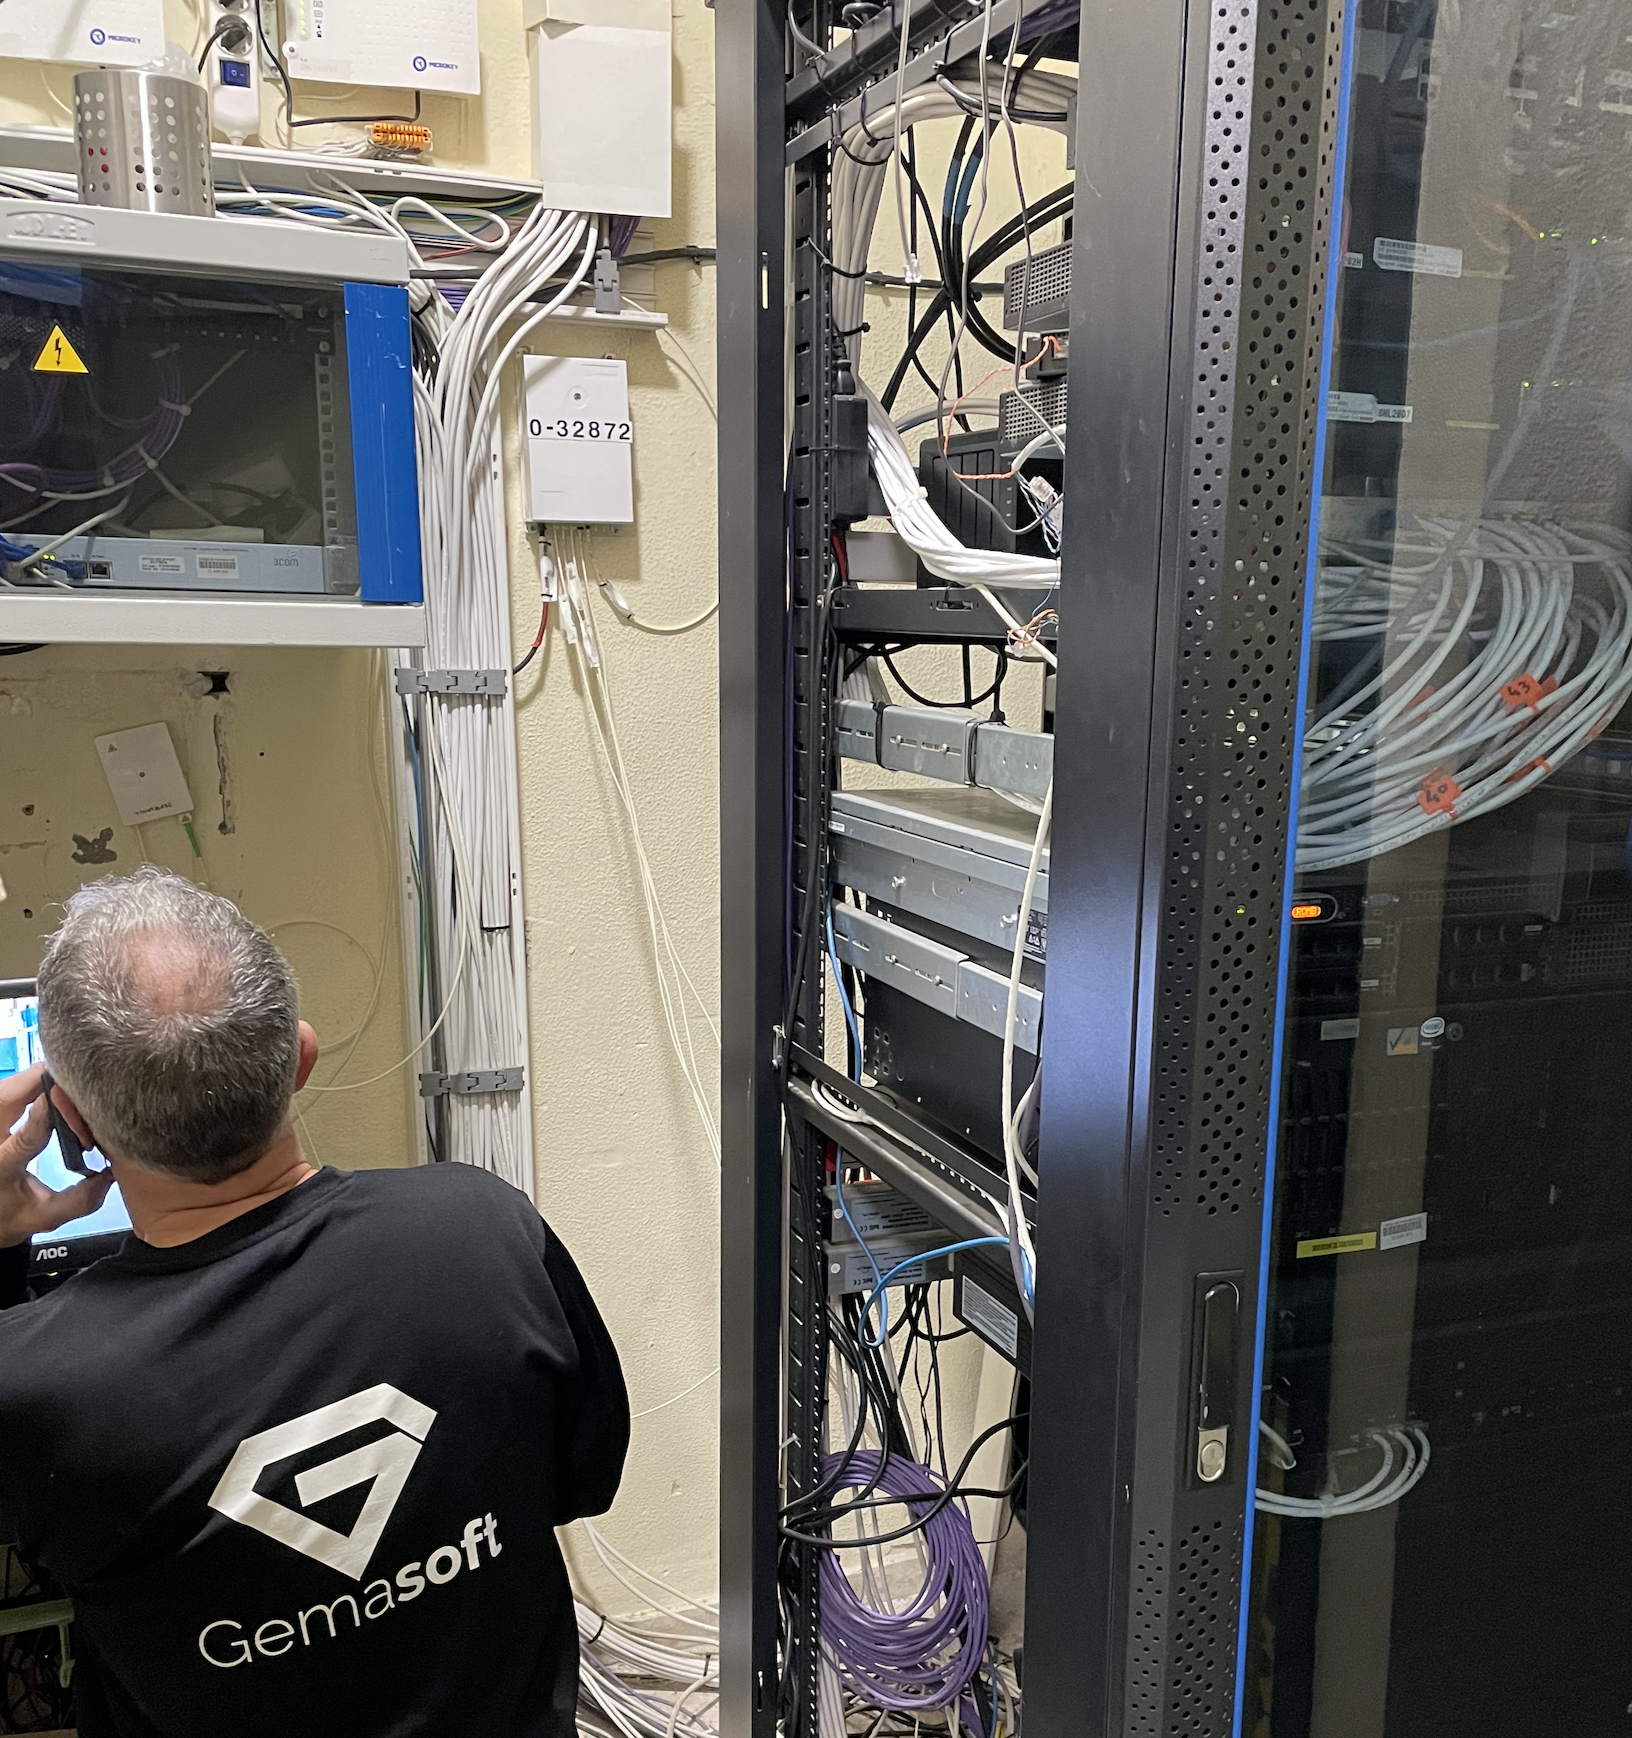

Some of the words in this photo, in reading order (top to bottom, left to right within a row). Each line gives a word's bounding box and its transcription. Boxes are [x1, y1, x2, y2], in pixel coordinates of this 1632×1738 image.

[529, 418, 631, 441] 0-32872
[1507, 681, 1531, 696] 43
[36, 1245, 69, 1262] AOC
[198, 1512, 503, 1668] Gemasoft
